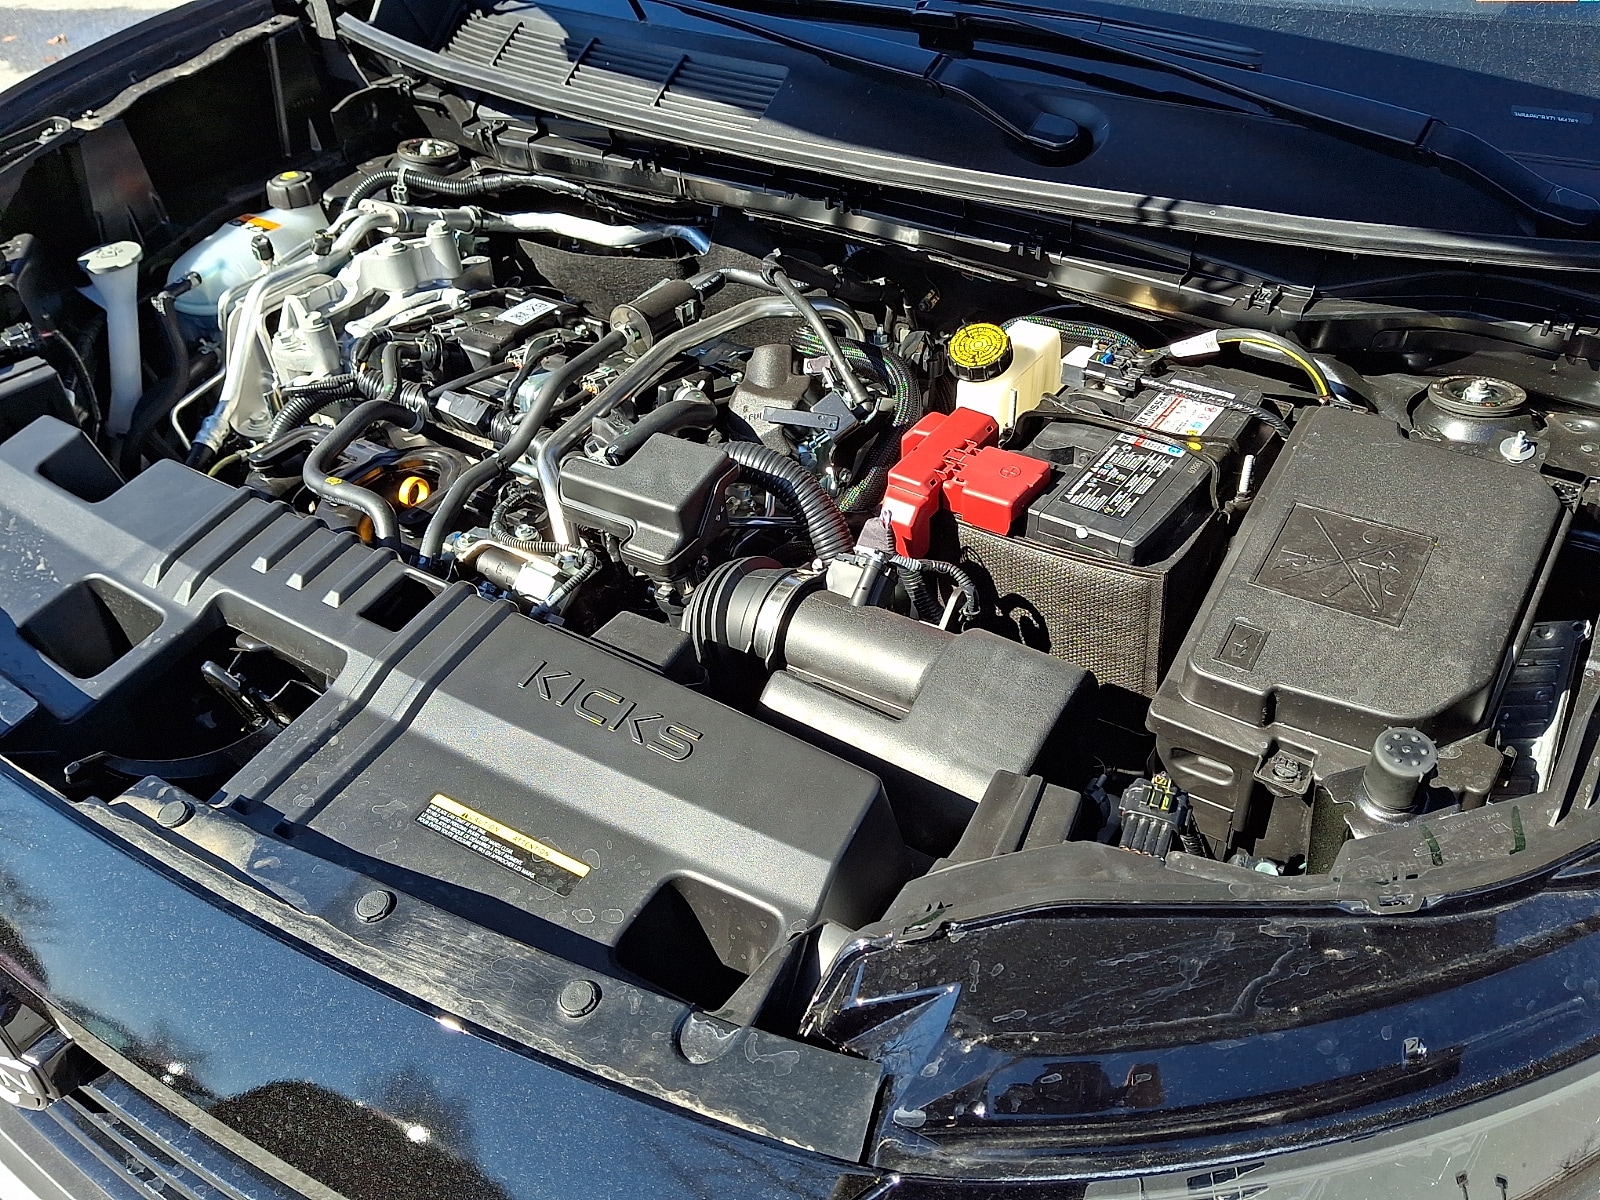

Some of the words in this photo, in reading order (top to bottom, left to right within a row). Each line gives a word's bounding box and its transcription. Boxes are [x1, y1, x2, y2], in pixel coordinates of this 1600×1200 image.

[517, 660, 704, 762] KICKS
[468, 814, 499, 832] CAUTION
[511, 835, 550, 857] ATTENTION
